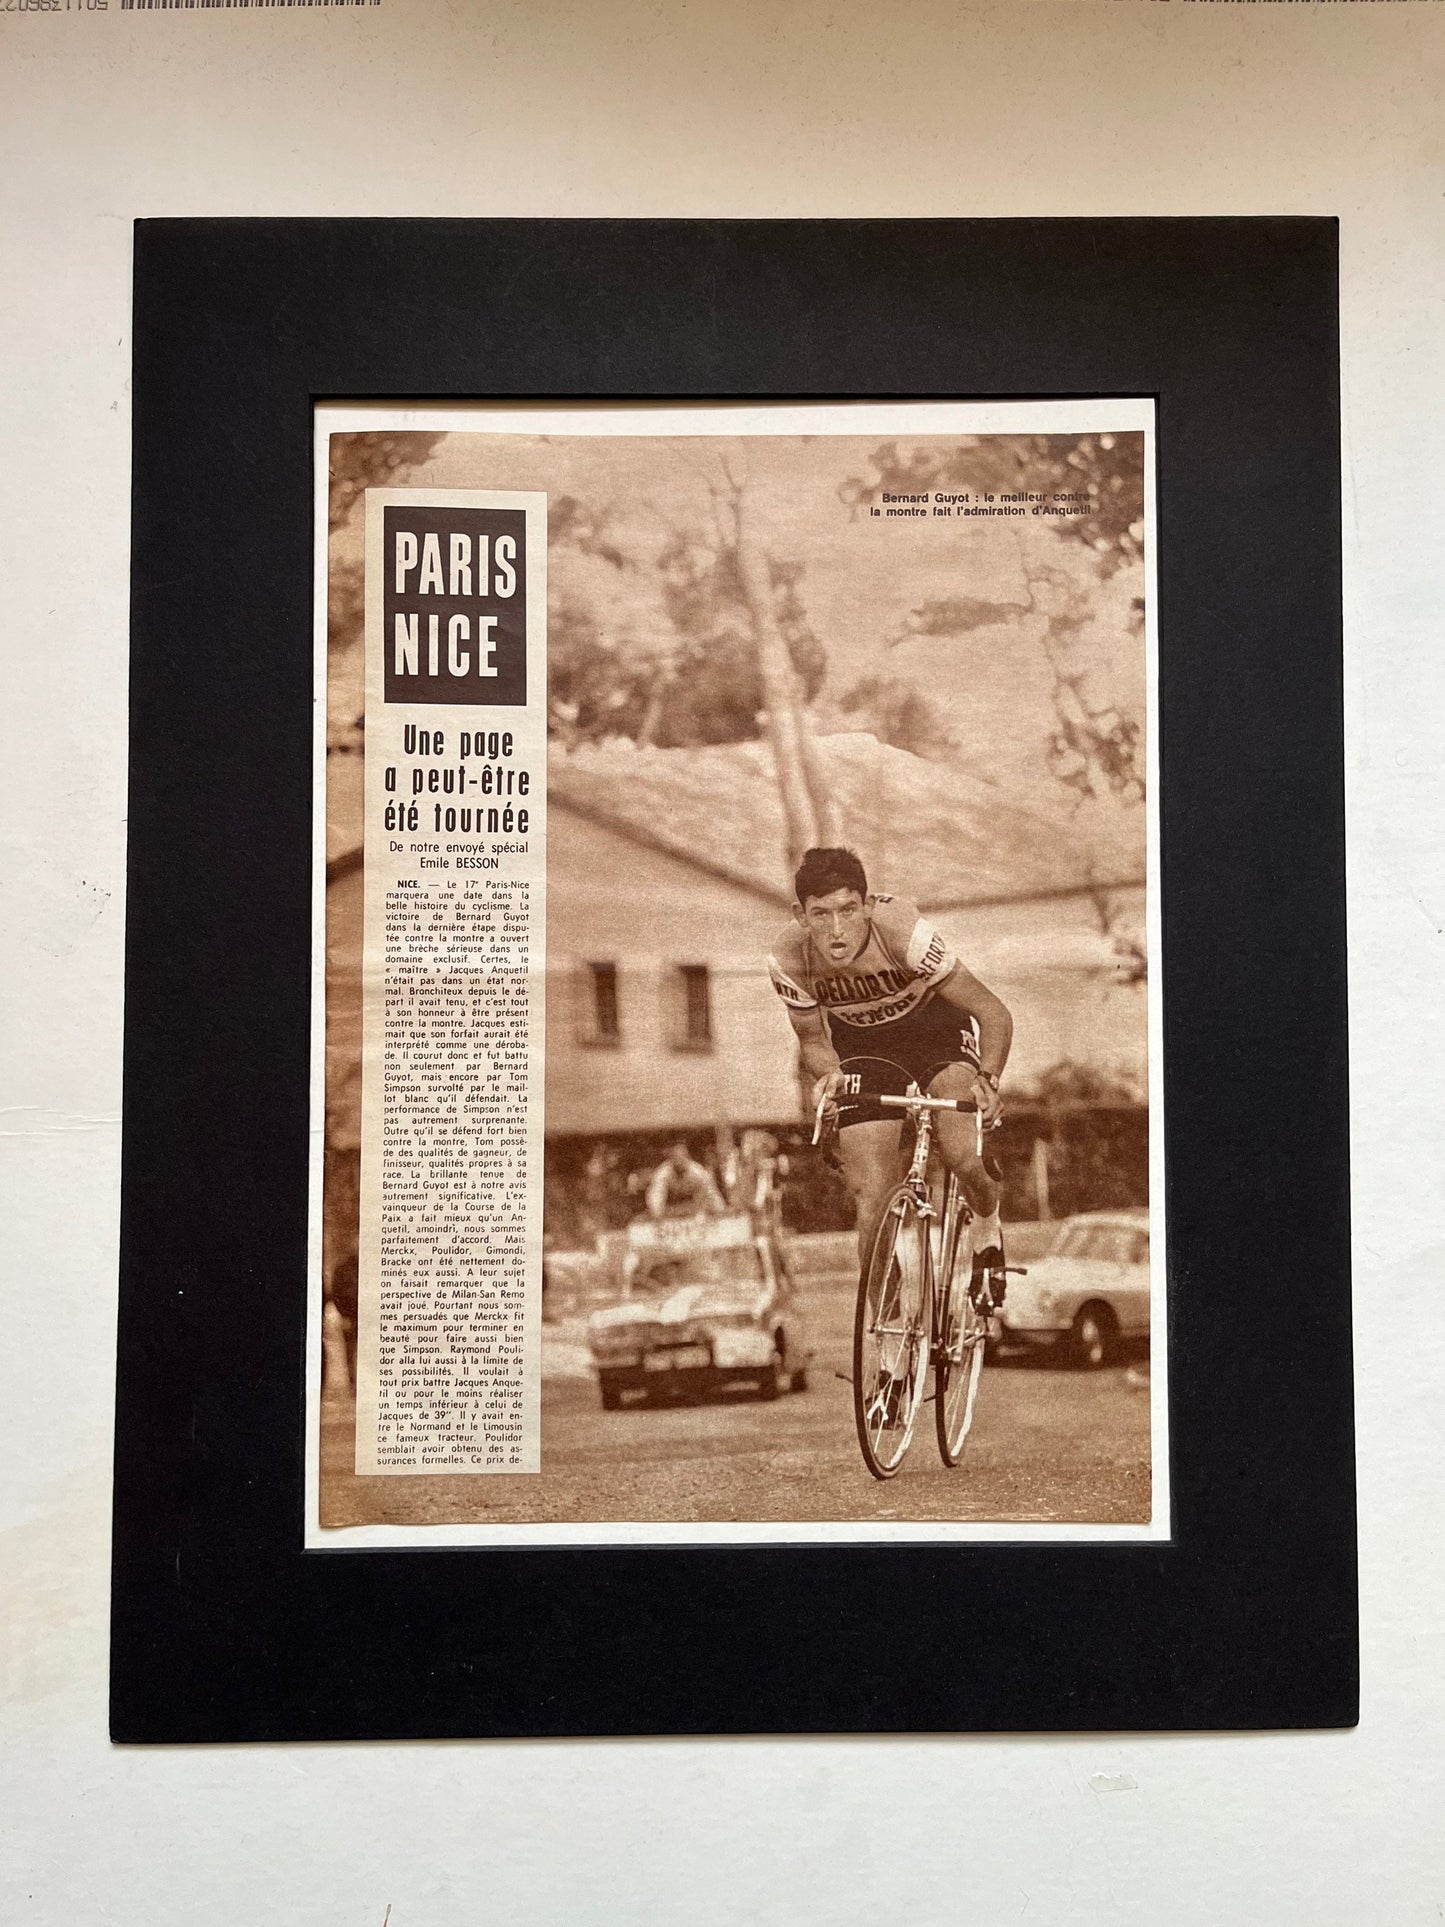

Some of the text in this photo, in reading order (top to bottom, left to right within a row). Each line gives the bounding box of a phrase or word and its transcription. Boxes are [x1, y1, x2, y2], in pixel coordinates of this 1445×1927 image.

[882, 493, 929, 503] Bernard
[935, 493, 970, 505] Guyot
[984, 493, 995, 503] le
[1000, 492, 1048, 502] meilleur
[1053, 492, 1090, 502] contre
[870, 505, 1091, 517] la montre fait l'admiration d'Anquetil
[395, 531, 517, 599] PARIS
[395, 613, 498, 677] NICE
[404, 724, 513, 760] Une page
[385, 765, 530, 796] a peut-être
[384, 799, 529, 833] été tournée
[389, 841, 528, 855] De notre envoyé spécial
[420, 857, 499, 868] Emile BESSON
[397, 880, 420, 888] NICE.
[447, 880, 457, 888] Le
[486, 880, 530, 888] Paris-Nice
[386, 893, 429, 901] marquera
[463, 891, 483, 899] date
[492, 891, 512, 899] dans
[522, 891, 529, 899] la
[386, 912, 529, 922] victoire de Bernard Guyot
[386, 934, 400, 942] tée
[404, 934, 434, 942] contre
[439, 934, 447, 942] la
[452, 934, 484, 942] montre
[500, 934, 529, 942] ouvert
[385, 955, 529, 965] domaine exclusif. Certes, le
[385, 987, 529, 997] mal. Bronchiteux depuis le dé-
[385, 1008, 390, 1016] à
[418, 1008, 455, 1016] honneur
[460, 1008, 466, 1016] à
[472, 1008, 490, 1016] être
[496, 1008, 528, 1018] présent
[385, 1030, 405, 1038] mait
[409, 1032, 426, 1040] que
[450, 1030, 479, 1038] forfait
[484, 1030, 510, 1038] aurait
[514, 1030, 528, 1038] été
[409, 1062, 454, 1070] seulement
[466, 1064, 481, 1072] par
[493, 1062, 528, 1070] Bernard
[384, 1084, 528, 1094] Simpson survolté par le mail-
[384, 1105, 528, 1115] performance de Simpson n'est
[384, 1126, 409, 1135] Outre
[413, 1126, 433, 1137] qu'il
[452, 1126, 482, 1135] défend
[487, 1126, 504, 1135] fort
[508, 1126, 527, 1135] bien
[383, 1159, 424, 1169] finisseur,
[428, 1159, 464, 1169] qualités
[468, 1161, 503, 1169] propres
[507, 1159, 512, 1167] à
[382, 1181, 526, 1191] Bernard Guyot est à notre avis
[382, 1203, 526, 1213] vainqueur de la Course de la
[381, 1224, 410, 1235] quetil,
[416, 1224, 458, 1235] amoindri,
[381, 1246, 525, 1256] Merckx, Poulidor, Gimondi,
[381, 1268, 407, 1276] minés
[435, 1268, 460, 1276] aussi.
[467, 1268, 474, 1276] A
[480, 1268, 497, 1276] leur
[504, 1268, 525, 1278] sujet
[380, 1301, 402, 1309] avait
[408, 1301, 428, 1311] joué.
[434, 1301, 473, 1309] Pourtant
[380, 1334, 524, 1344] beauté pour faire aussi bien
[380, 1378, 523, 1388] tout prix battre Jacques Anque-
[378, 1422, 522, 1430] tre le Normand et le Limousin
[422, 1456, 466, 1464] formelles.
[470, 1456, 482, 1464] Ce
[486, 1456, 504, 1466] prix
[509, 1456, 522, 1464] de-
